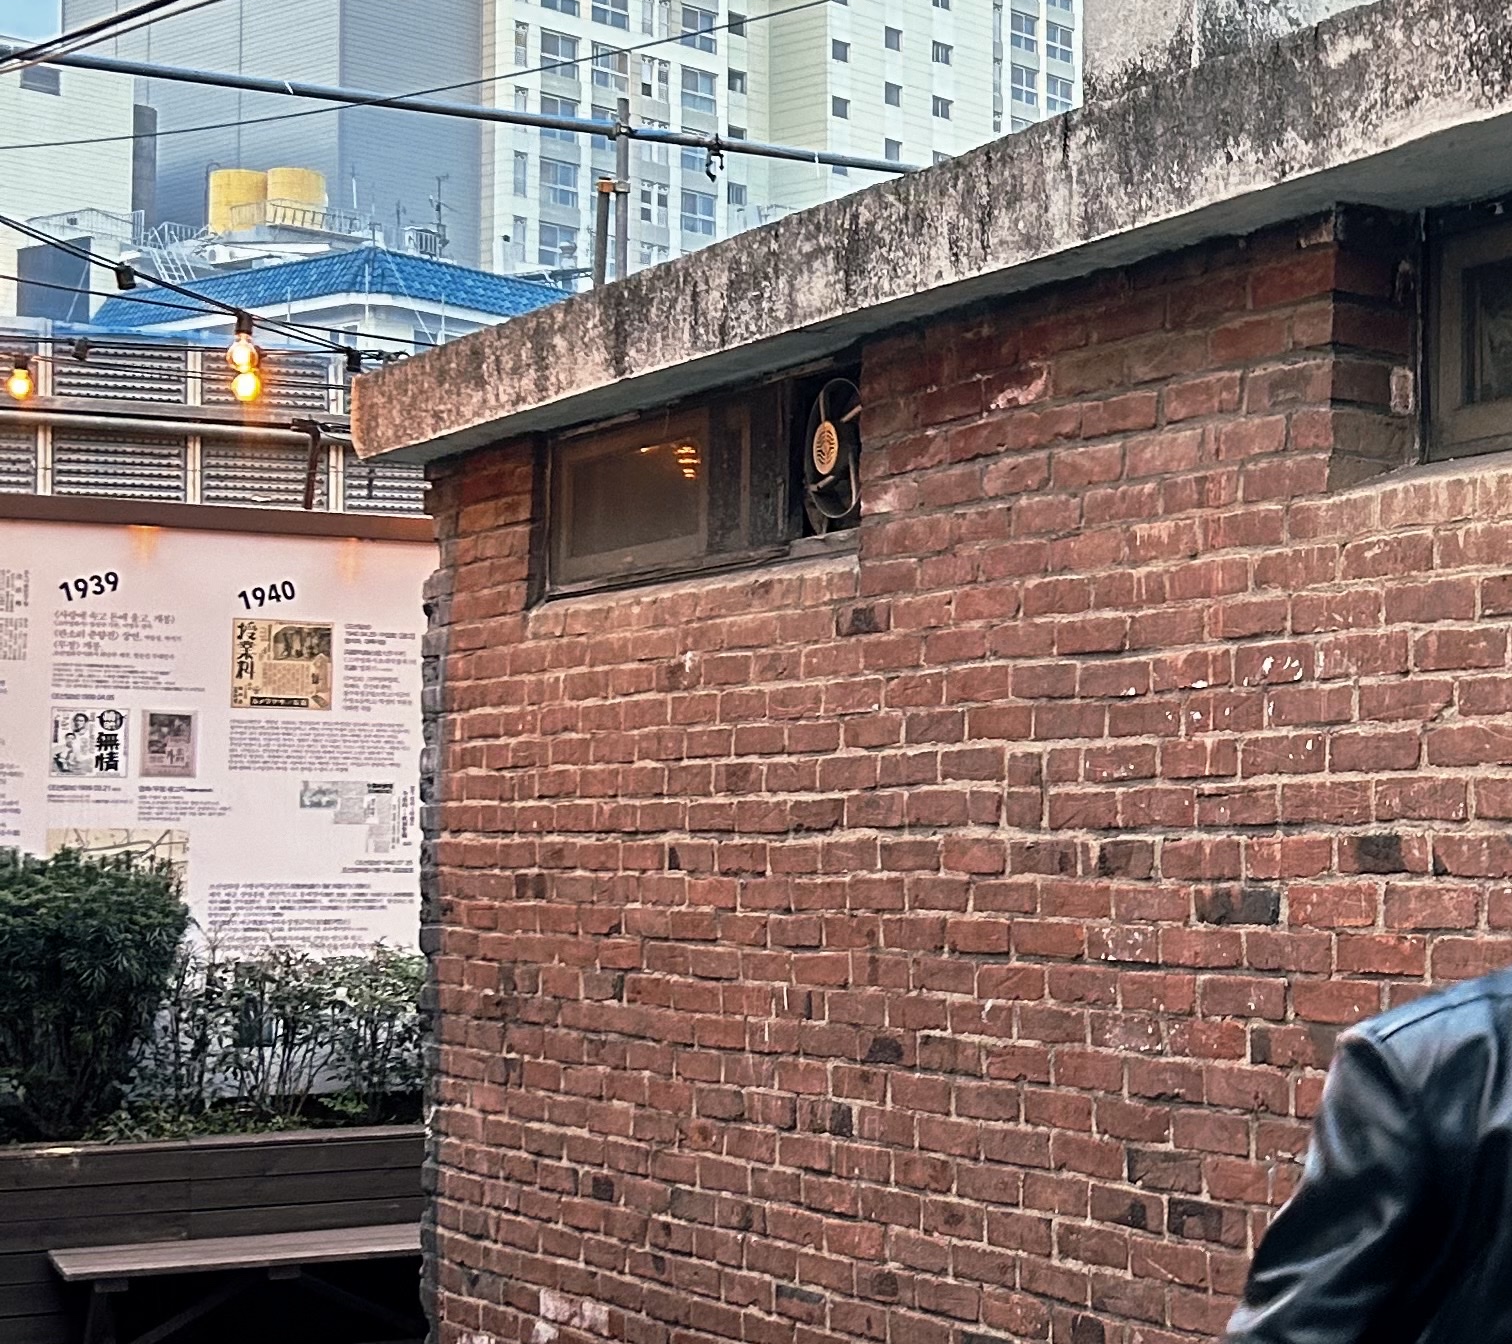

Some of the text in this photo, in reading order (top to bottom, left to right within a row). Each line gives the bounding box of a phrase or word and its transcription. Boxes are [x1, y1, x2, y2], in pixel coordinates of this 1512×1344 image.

[58, 571, 119, 602] 1939
[237, 580, 296, 610] 1940
[95, 731, 121, 772] 無情
